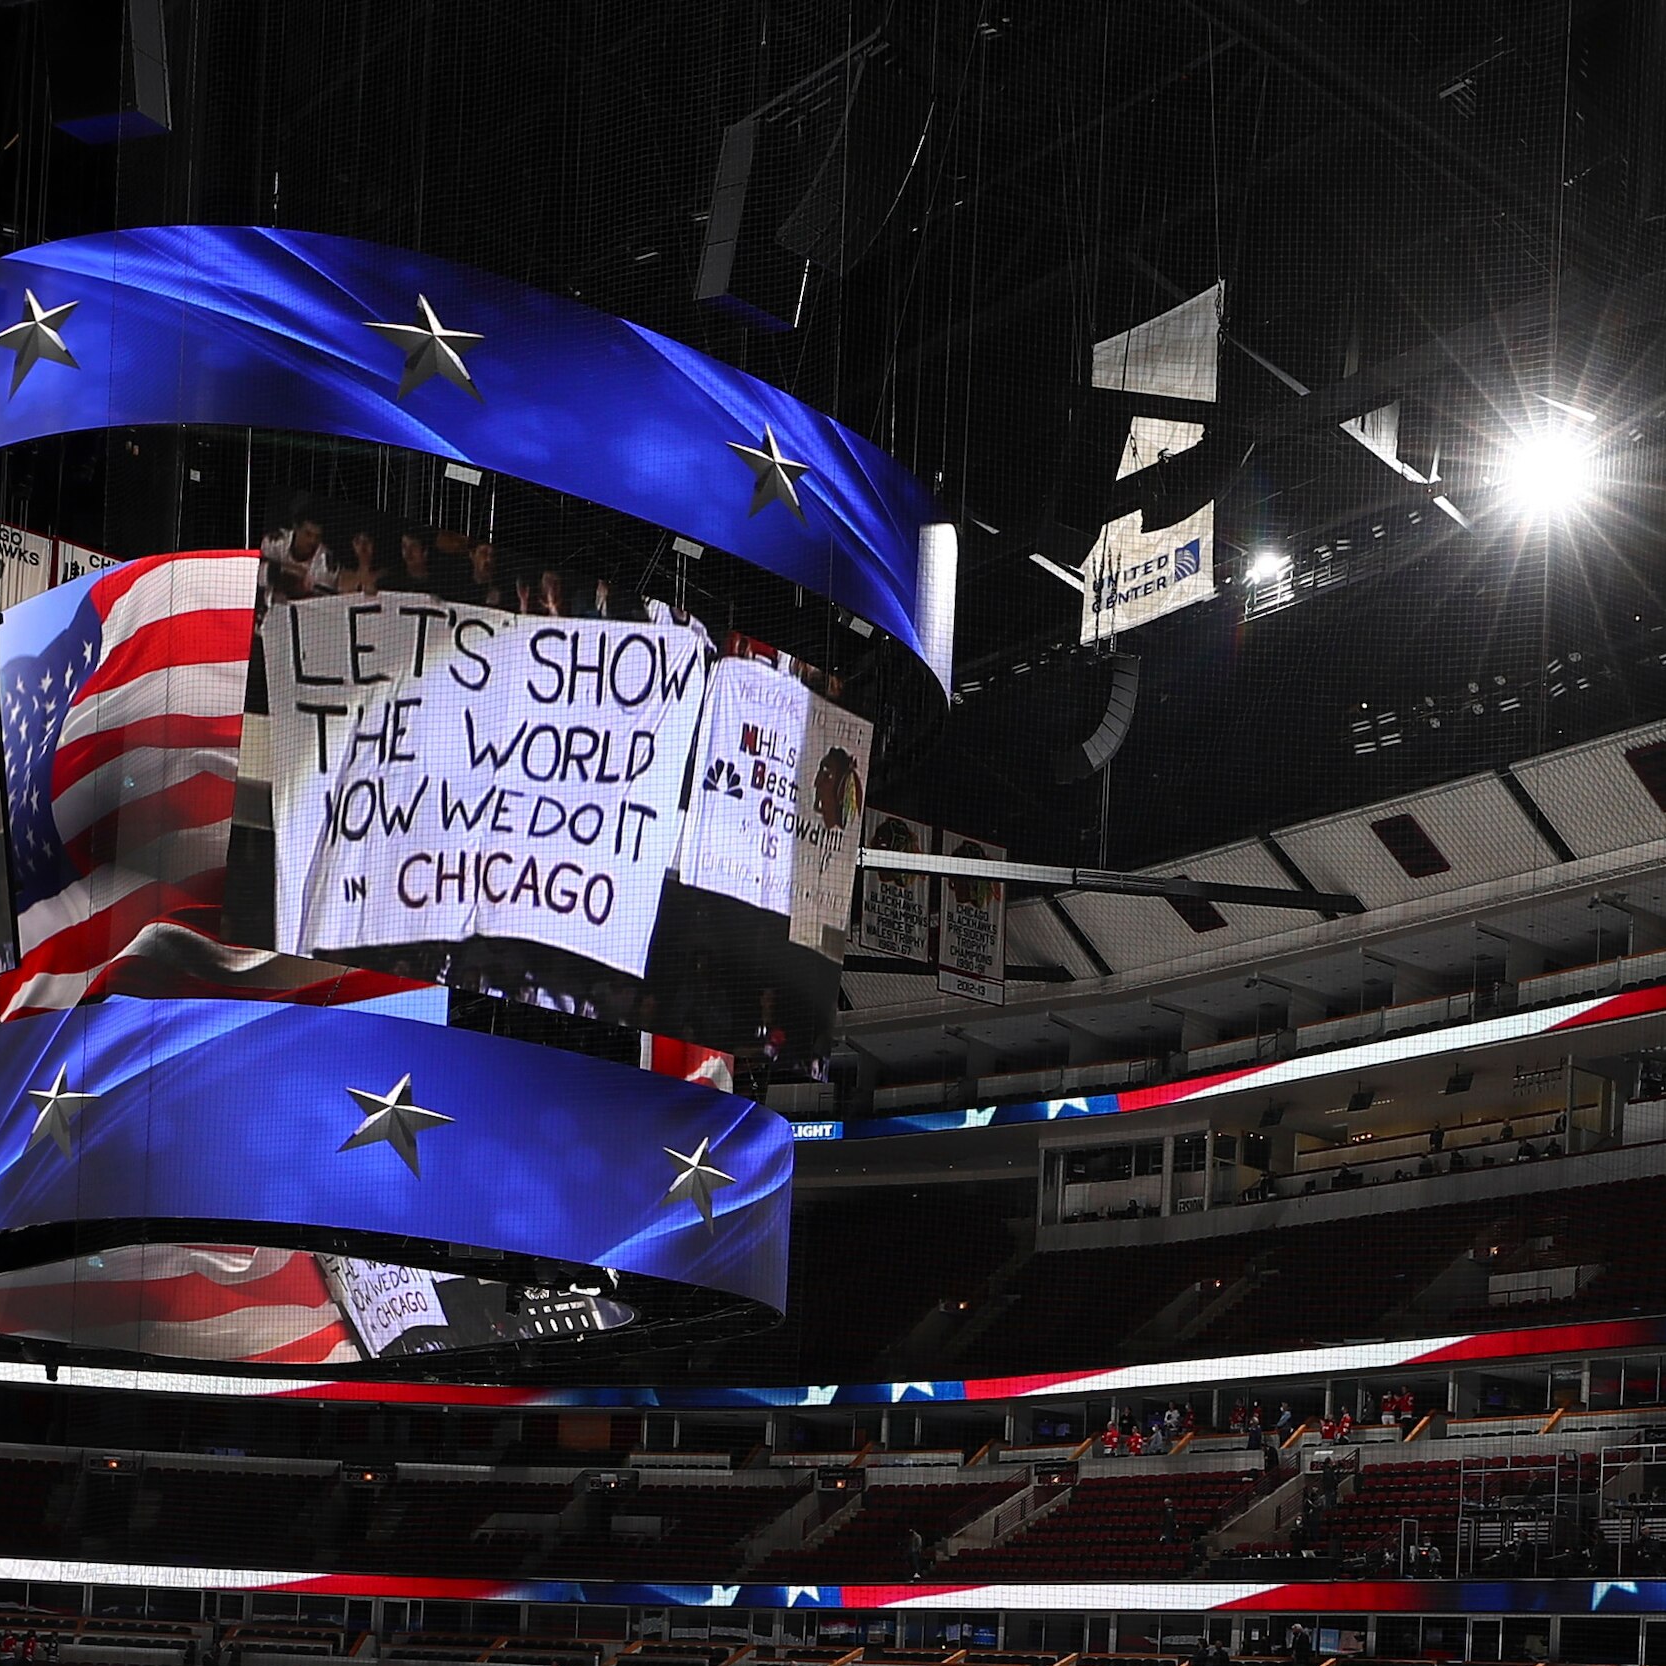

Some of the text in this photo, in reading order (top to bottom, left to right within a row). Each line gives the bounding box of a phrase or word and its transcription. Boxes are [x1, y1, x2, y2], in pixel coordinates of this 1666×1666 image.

[1091, 577, 1167, 614] CENTER
[1093, 552, 1169, 594] UNITED
[527, 629, 696, 708] SHOW
[296, 696, 423, 774] THE
[464, 708, 656, 784] WORLD
[750, 759, 799, 804] Best
[397, 853, 616, 924] CHICAGO
[376, 1291, 428, 1329] CHICAGO
